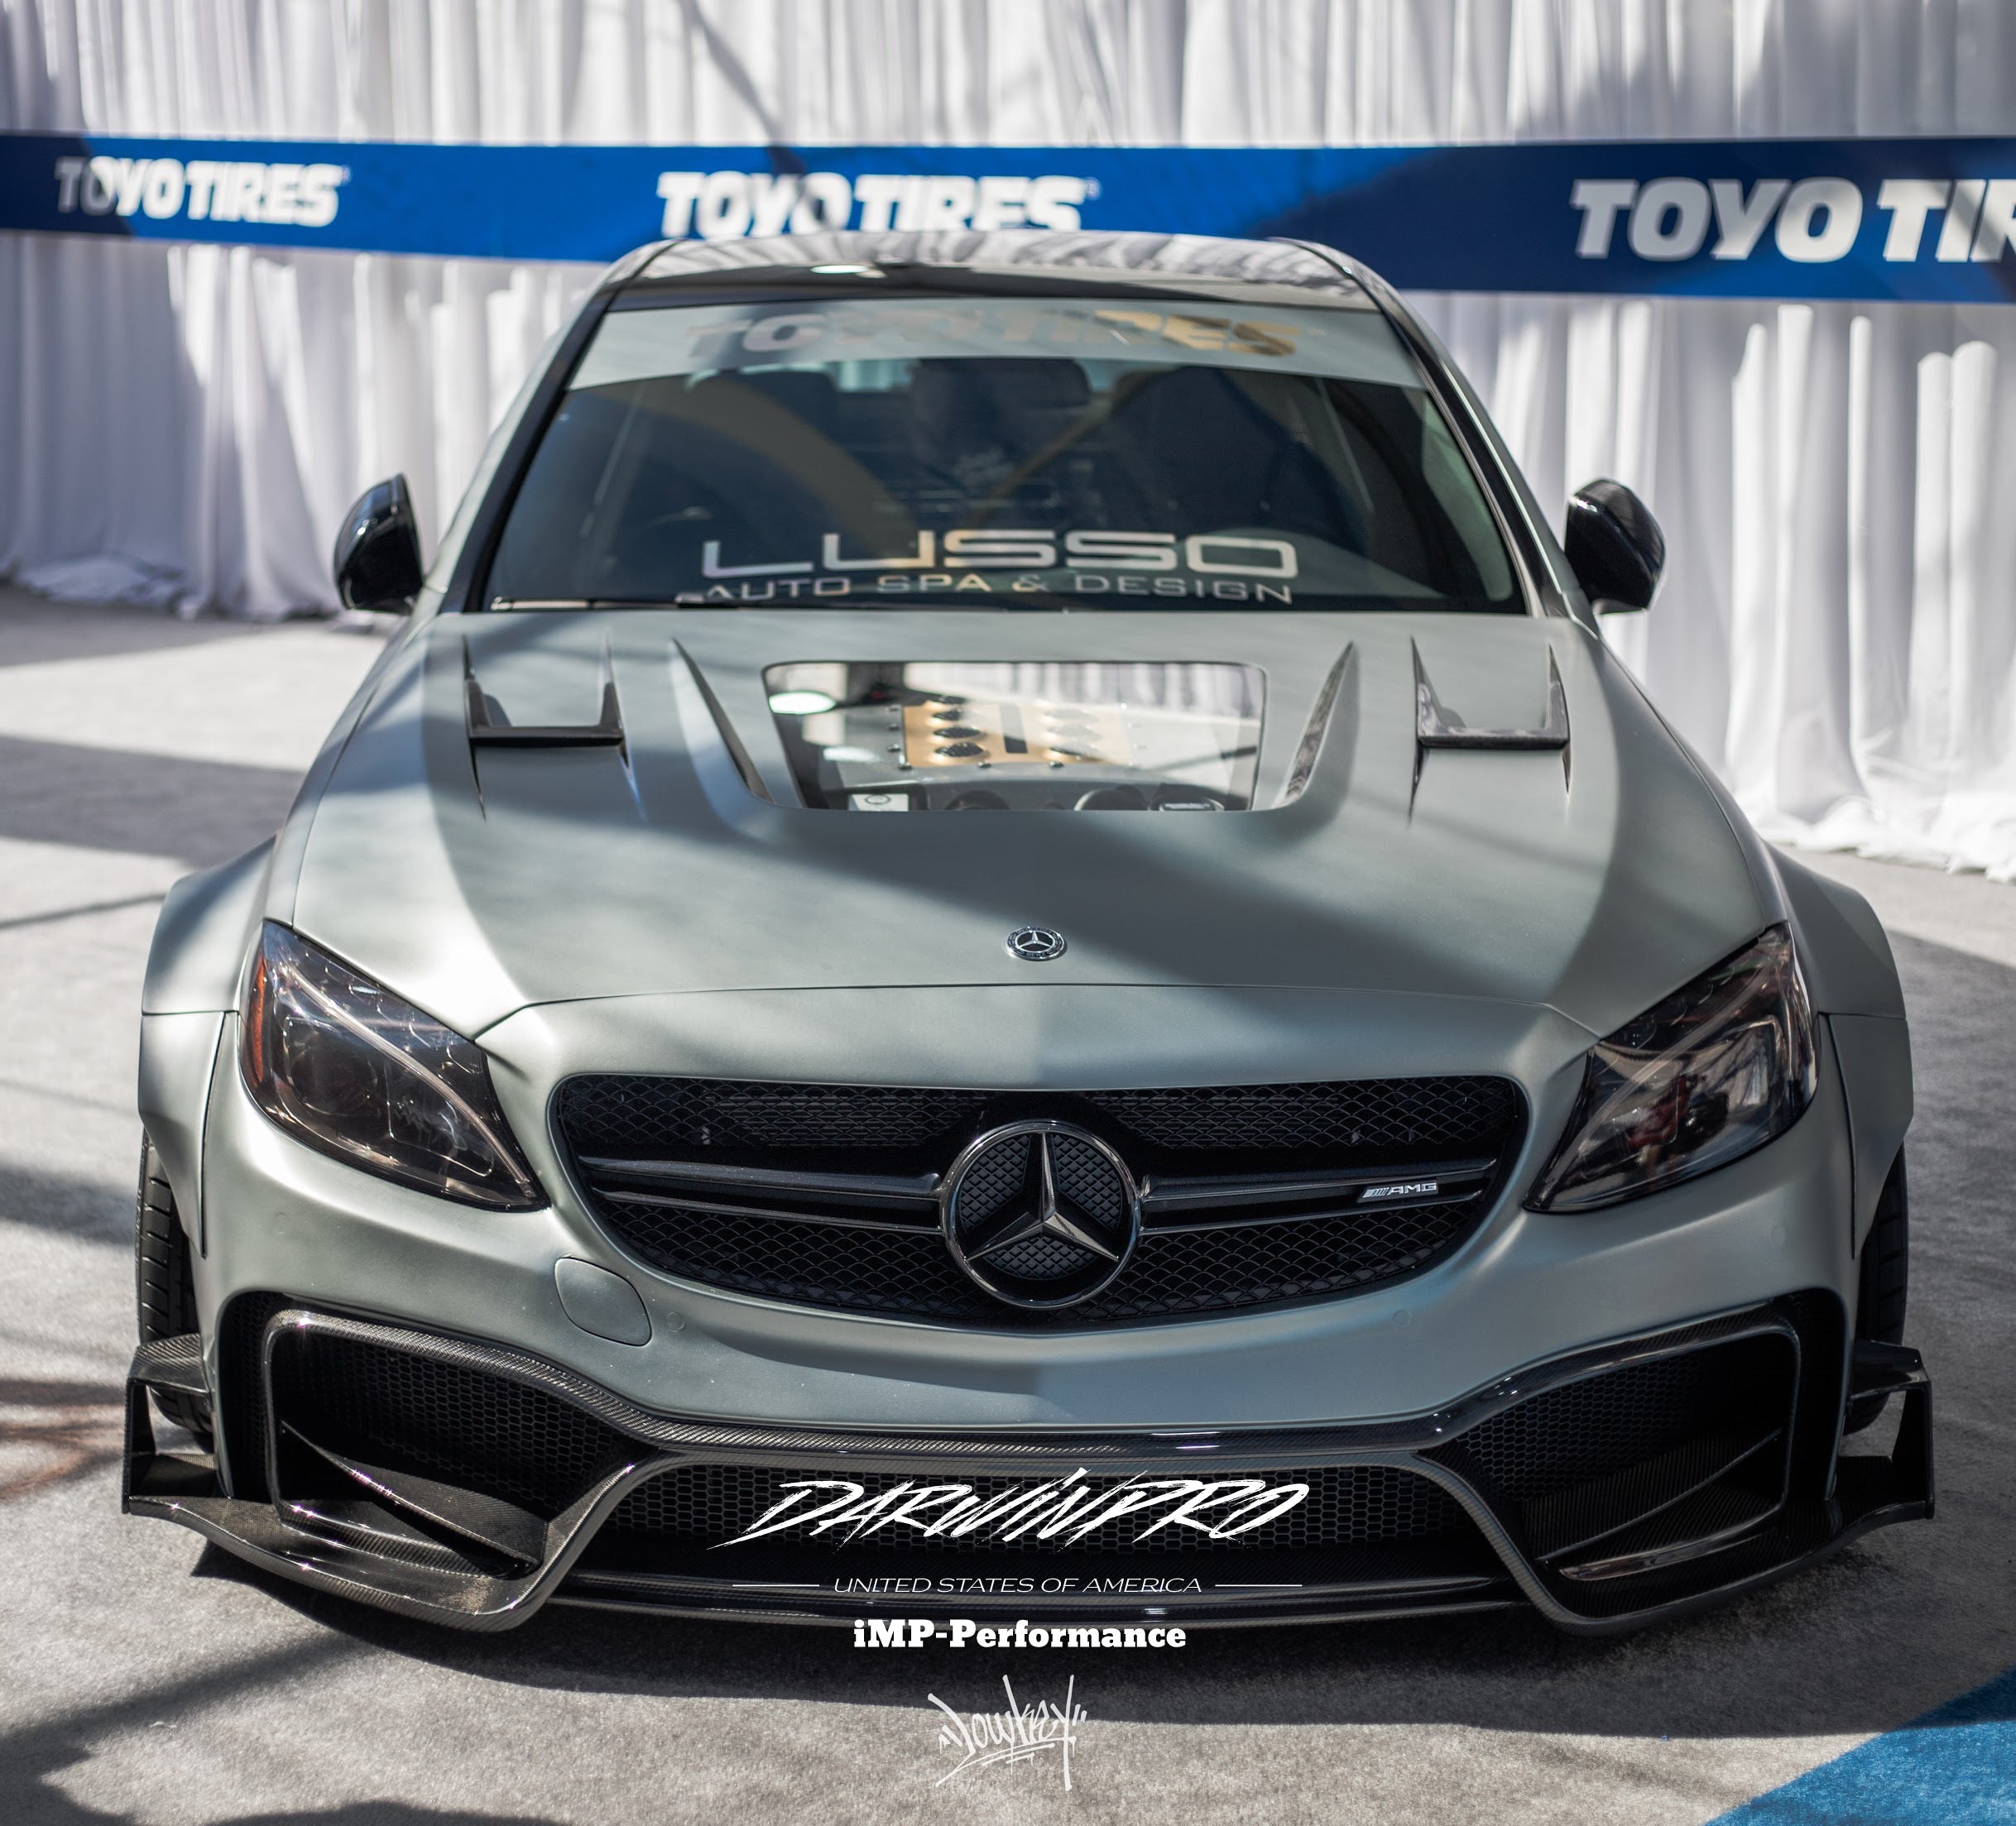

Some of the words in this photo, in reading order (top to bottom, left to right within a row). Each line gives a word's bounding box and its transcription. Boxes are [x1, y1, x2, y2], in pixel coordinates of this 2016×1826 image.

[55, 156, 185, 219] TOYO
[186, 161, 341, 228] TIRES
[657, 170, 852, 237] TOYO
[1572, 177, 1863, 262] TOYO
[703, 529, 1298, 579] LUSSO
[707, 577, 851, 601] AUTO
[876, 573, 992, 594] SPA
[1011, 573, 1049, 593] &
[1074, 574, 1294, 605] DESIGN
[1386, 1182, 1437, 1196] AMG
